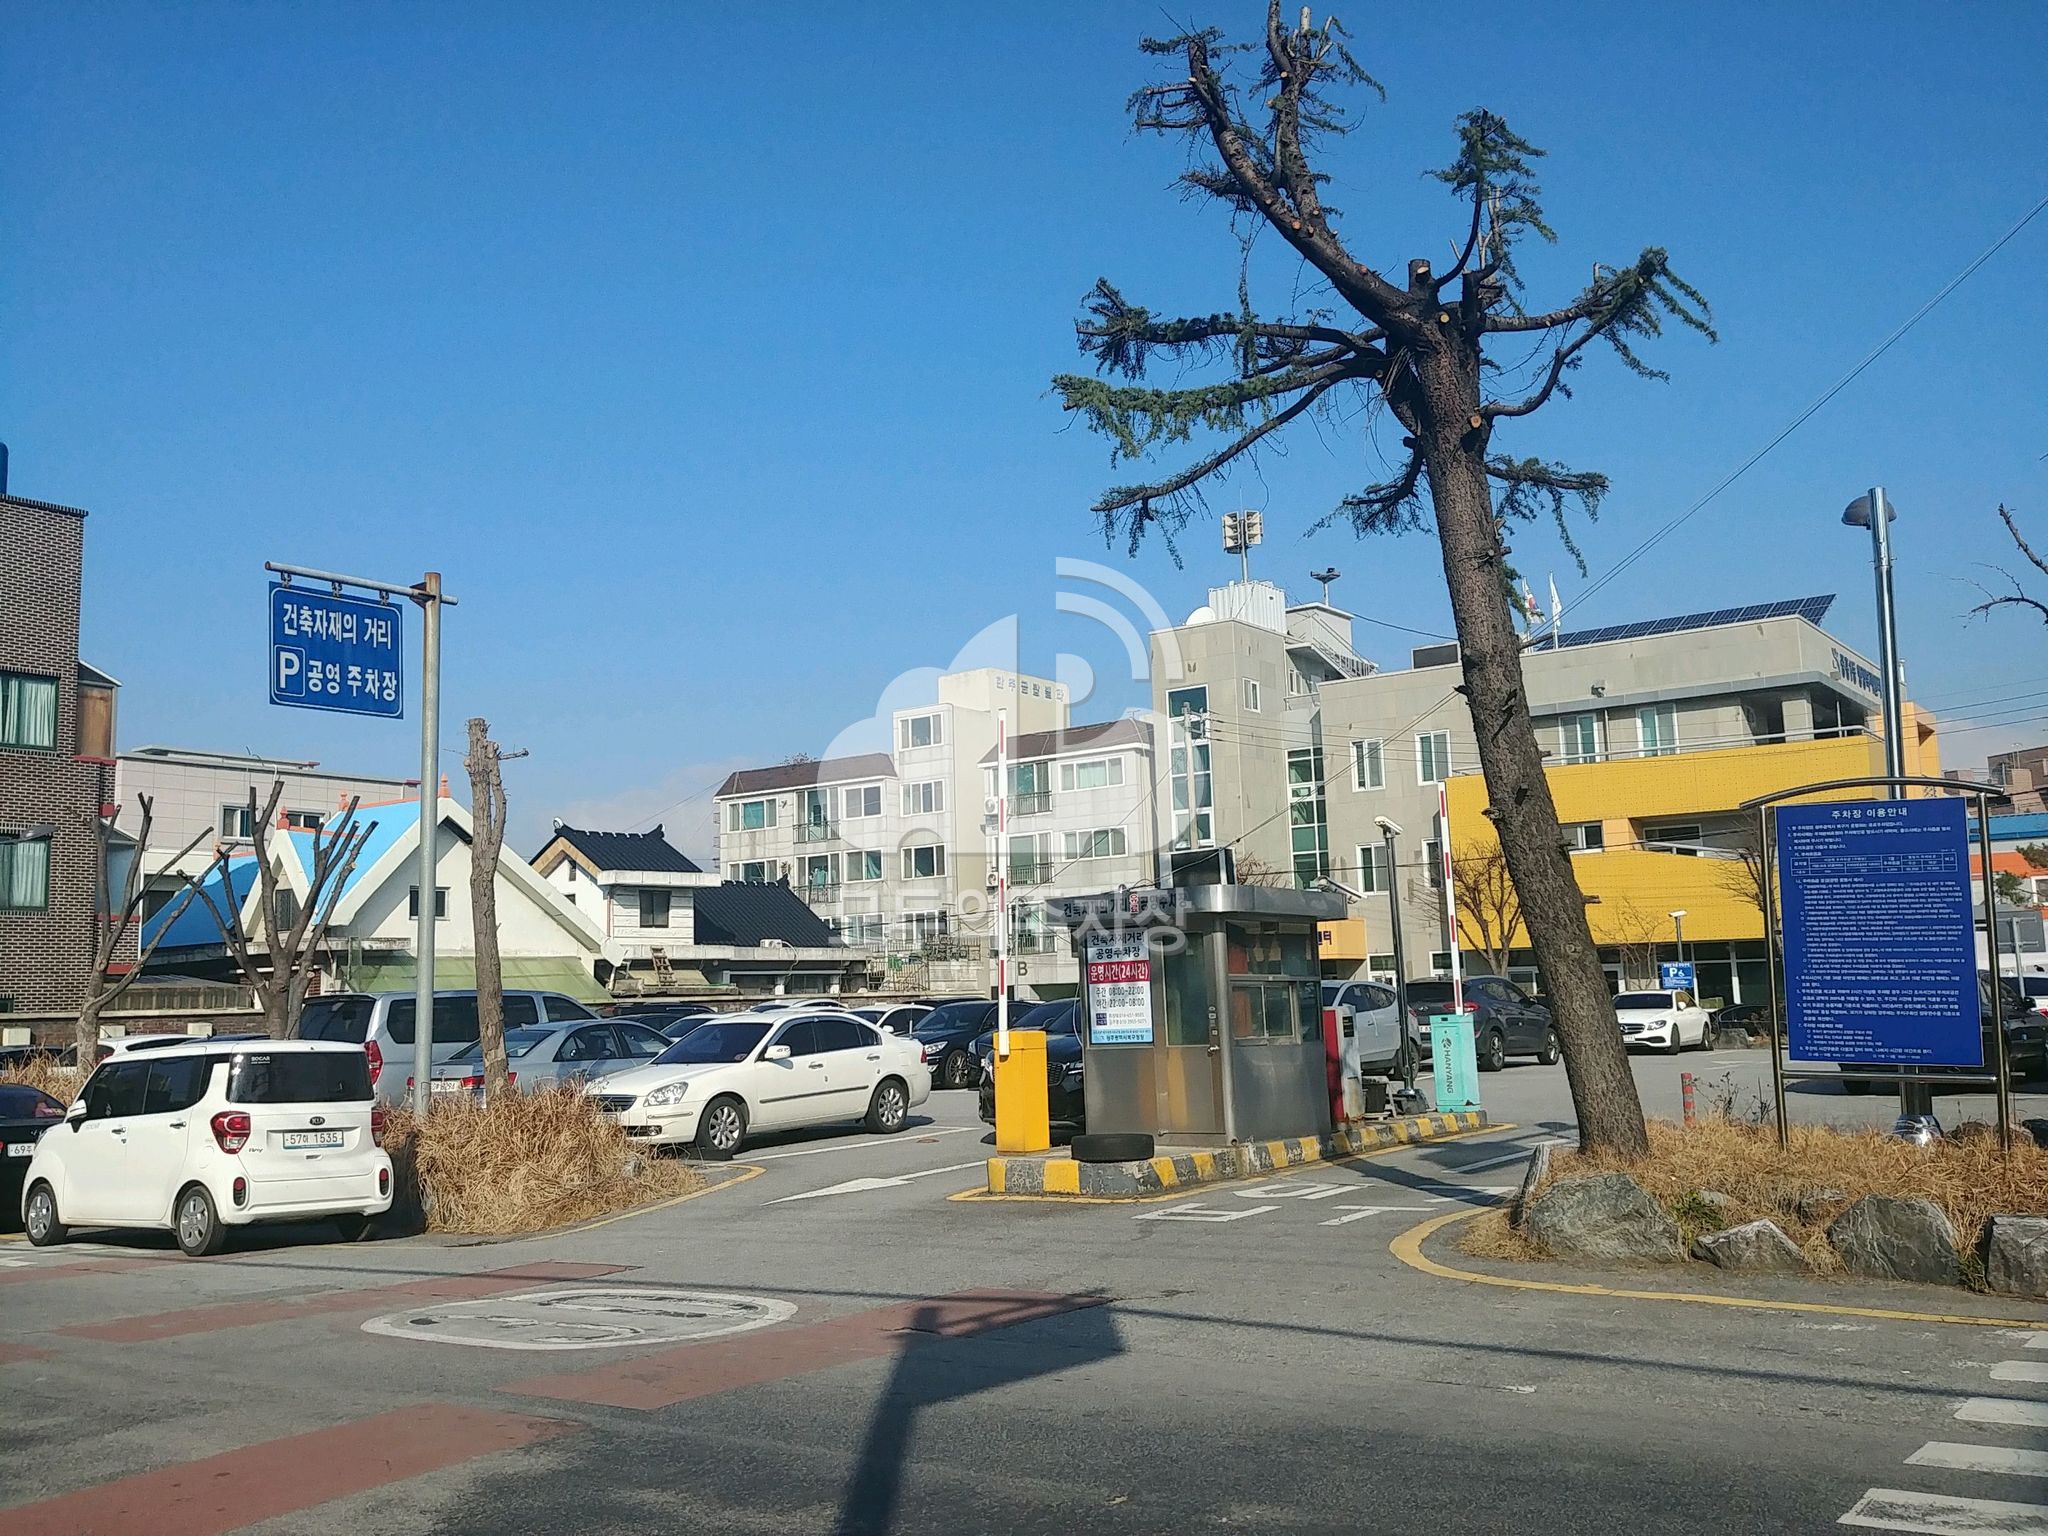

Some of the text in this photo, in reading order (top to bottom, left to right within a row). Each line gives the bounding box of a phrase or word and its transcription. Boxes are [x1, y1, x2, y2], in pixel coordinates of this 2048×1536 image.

[283, 603, 392, 650] 건축자재의 거리
[280, 651, 398, 701] P 공영 주차장
[1831, 807, 1908, 820] 주차장 이용안내
[1095, 946, 1141, 960] 공영주차장
[1017, 961, 1028, 976] B
[1096, 986, 1107, 998] 주간
[1096, 998, 1107, 1009] 야간
[1444, 1049, 1454, 1094] HANYANG
[314, 1132, 338, 1144] 1535
